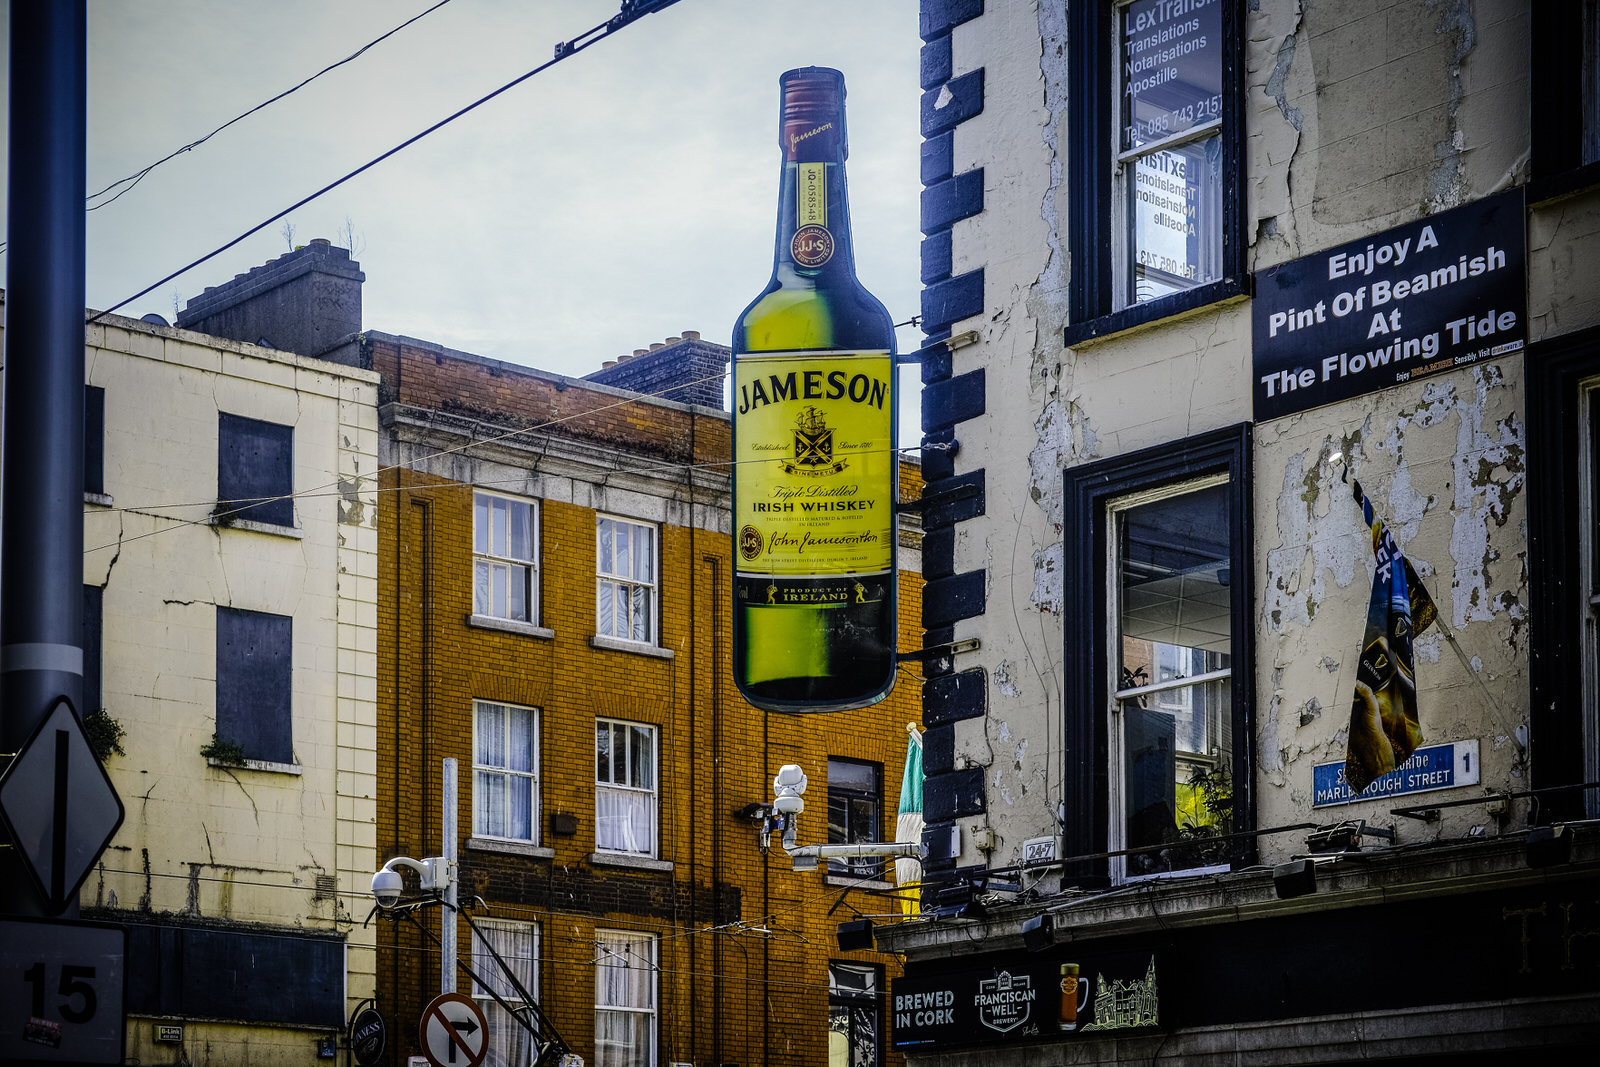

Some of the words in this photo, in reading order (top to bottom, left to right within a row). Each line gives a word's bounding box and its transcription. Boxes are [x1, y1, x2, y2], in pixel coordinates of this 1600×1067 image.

[1125, 18, 1200, 56] Translations
[1125, 35, 1207, 76] Notarisations
[1125, 67, 1178, 97] Apostille
[790, 122, 832, 153] Jameson
[1124, 121, 1144, 143] Tel:
[1147, 114, 1169, 135] 085
[1172, 104, 1194, 126] 743
[1328, 237, 1412, 280] Enjoy
[1415, 224, 1439, 254] A
[1268, 299, 1326, 338] Pint
[1331, 286, 1367, 318] Of
[1371, 246, 1506, 307] Beamish
[1366, 307, 1402, 339] At
[1260, 366, 1316, 398] The
[1321, 332, 1440, 383] Flowing
[1445, 309, 1517, 346] Tide
[1396, 371, 1411, 382] Enjoy
[739, 370, 887, 415] JAMESON
[753, 502, 794, 512] IRISH
[800, 500, 876, 512] WHISKEY
[805, 484, 858, 498] Distilled
[767, 531, 799, 555] John
[783, 592, 848, 601] IRELAND
[1462, 752, 1471, 773] 1
[1408, 769, 1451, 788] STREET
[23, 962, 98, 1025] 15
[895, 990, 955, 1012] BREWED
[974, 989, 1036, 1007] FRANCISCAN
[895, 1012, 911, 1029] IN
[915, 1008, 955, 1027] CORK
[991, 1003, 1018, 1017] WELL
